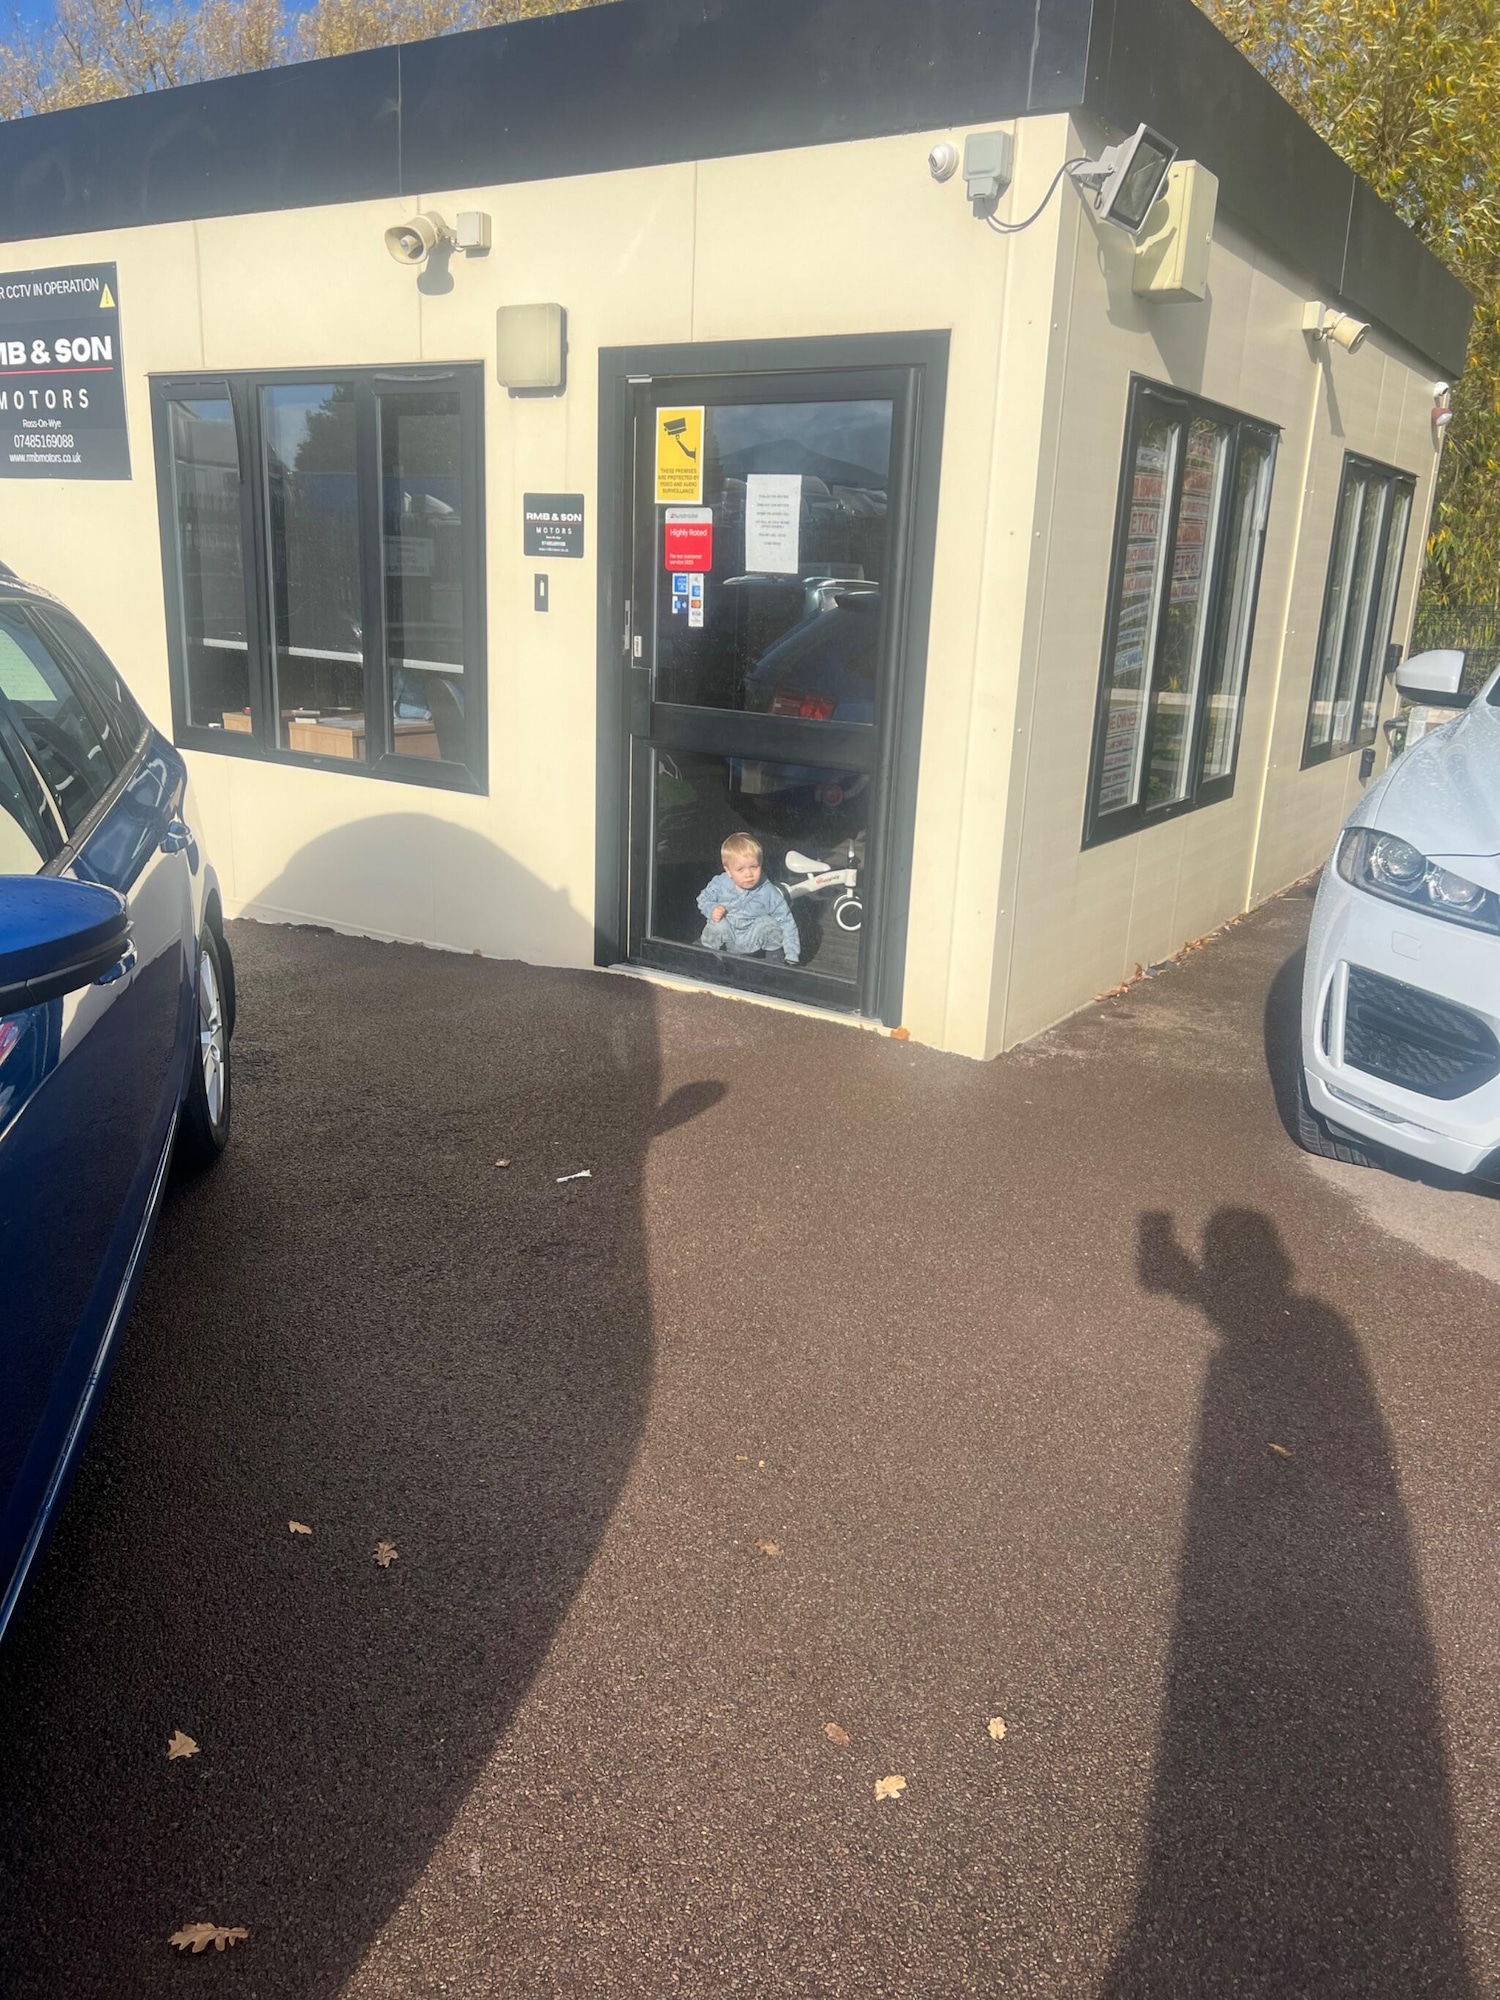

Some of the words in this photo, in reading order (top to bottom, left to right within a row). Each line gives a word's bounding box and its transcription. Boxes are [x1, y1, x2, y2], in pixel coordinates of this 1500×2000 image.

[6, 284, 32, 299] CCTV
[33, 283, 43, 297] IN
[44, 277, 99, 296] OPERATION
[30, 339, 52, 364] &
[54, 335, 113, 363] SON
[0, 388, 89, 410] MOTORS
[22, 418, 62, 430] Ross-On-Wye
[14, 434, 74, 448] 07485169088
[9, 452, 82, 463] www.rmbmotors.co.uk
[526, 512, 550, 521] RMB
[551, 512, 560, 521] &
[560, 513, 582, 522] SON
[536, 526, 572, 535] MOTORS
[670, 528, 689, 538] Highly
[689, 528, 708, 537] Rated
